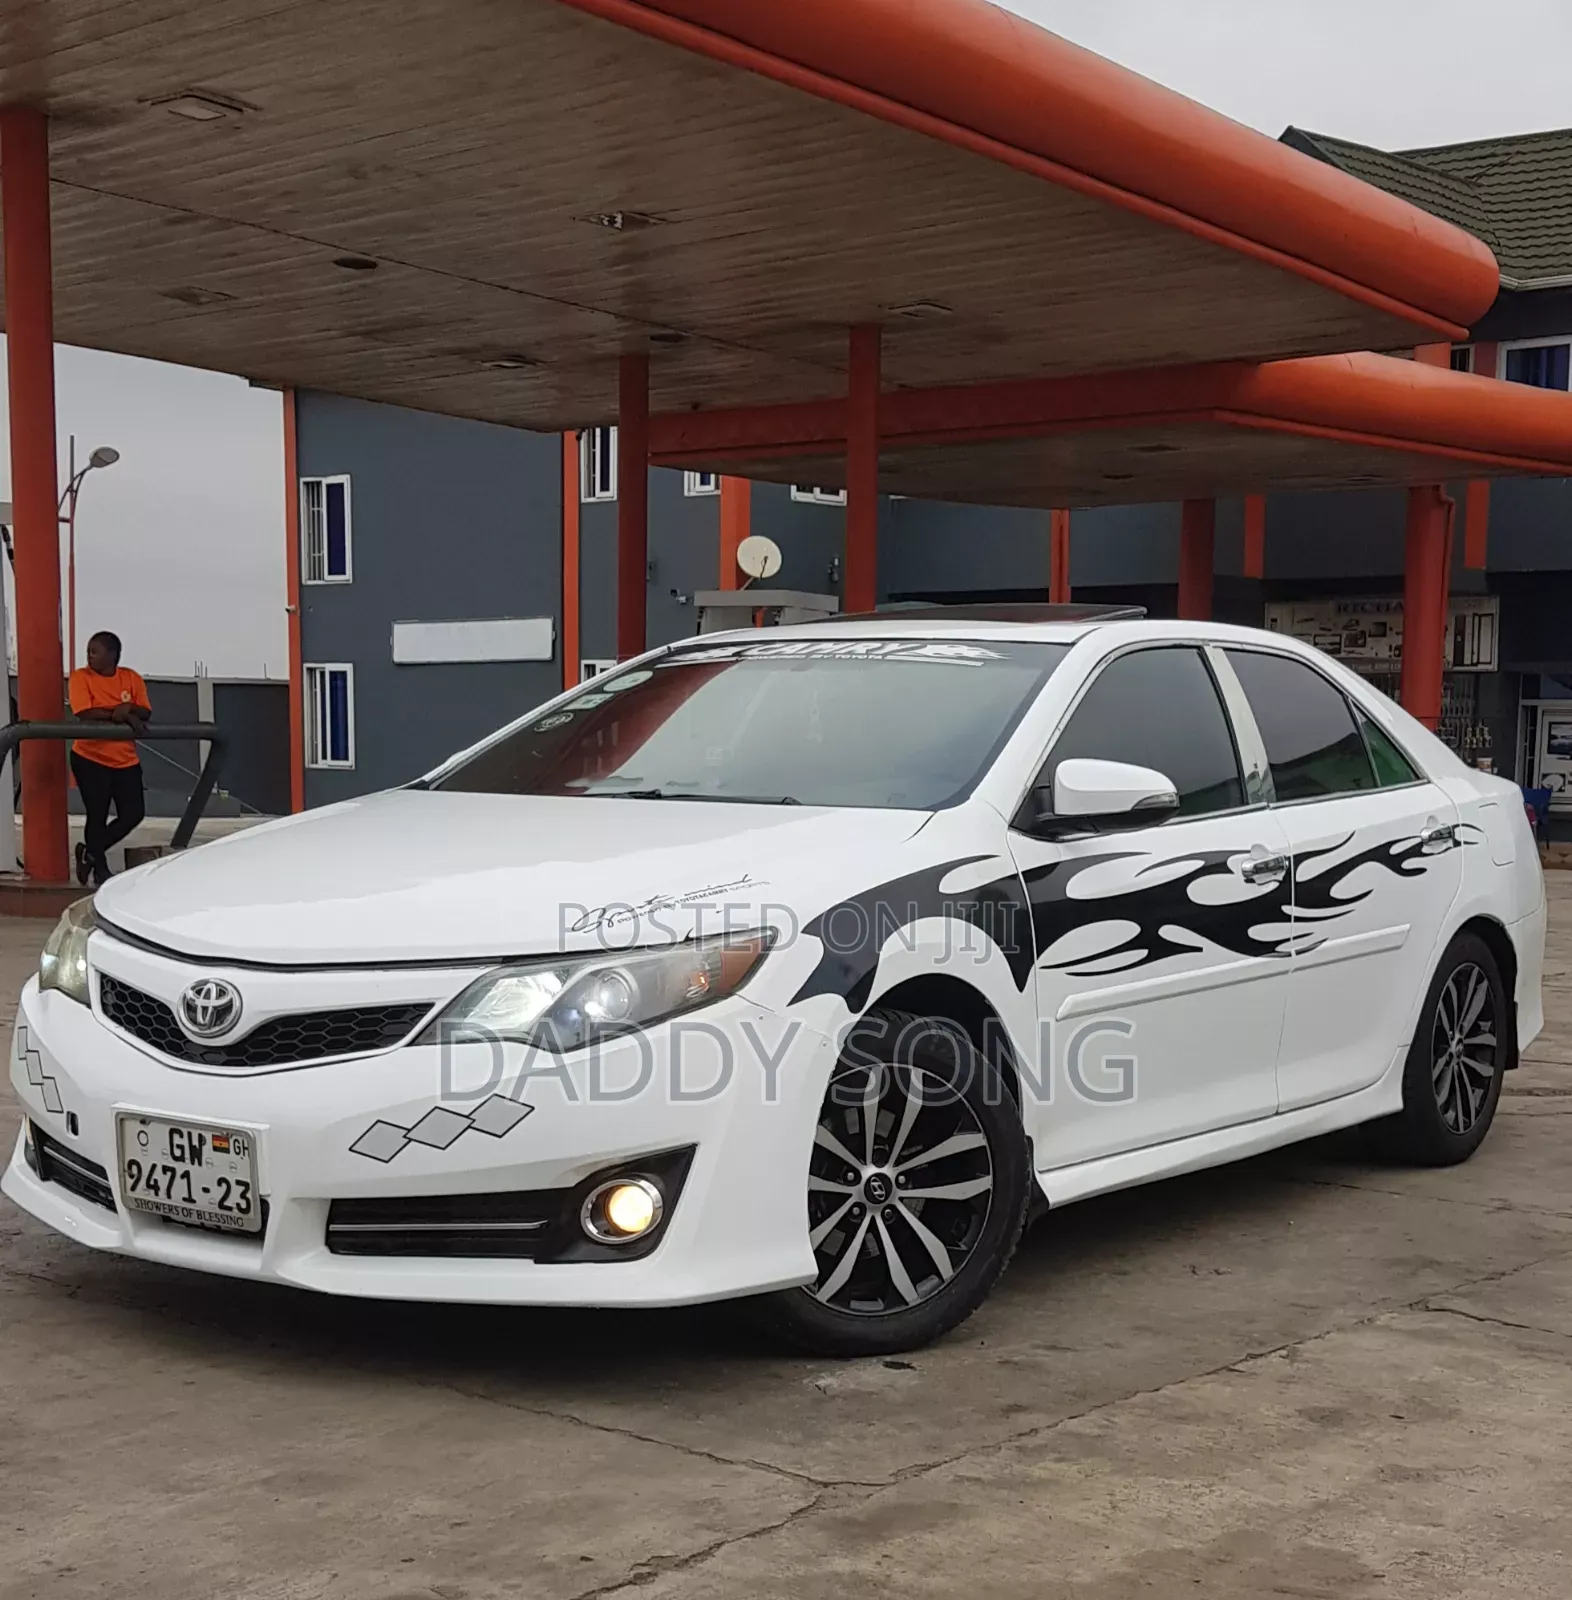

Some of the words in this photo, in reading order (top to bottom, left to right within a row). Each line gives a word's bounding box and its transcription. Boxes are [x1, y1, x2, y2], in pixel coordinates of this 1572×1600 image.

[741, 642, 918, 656] CAMRY
[834, 653, 885, 661] TOYOTA
[168, 1127, 206, 1167] GW
[232, 1138, 250, 1158] GH
[126, 1158, 252, 1215] 9471-23
[133, 1197, 180, 1217] SHOWERS
[181, 1207, 195, 1219] OF
[196, 1209, 245, 1229] BLESSING
